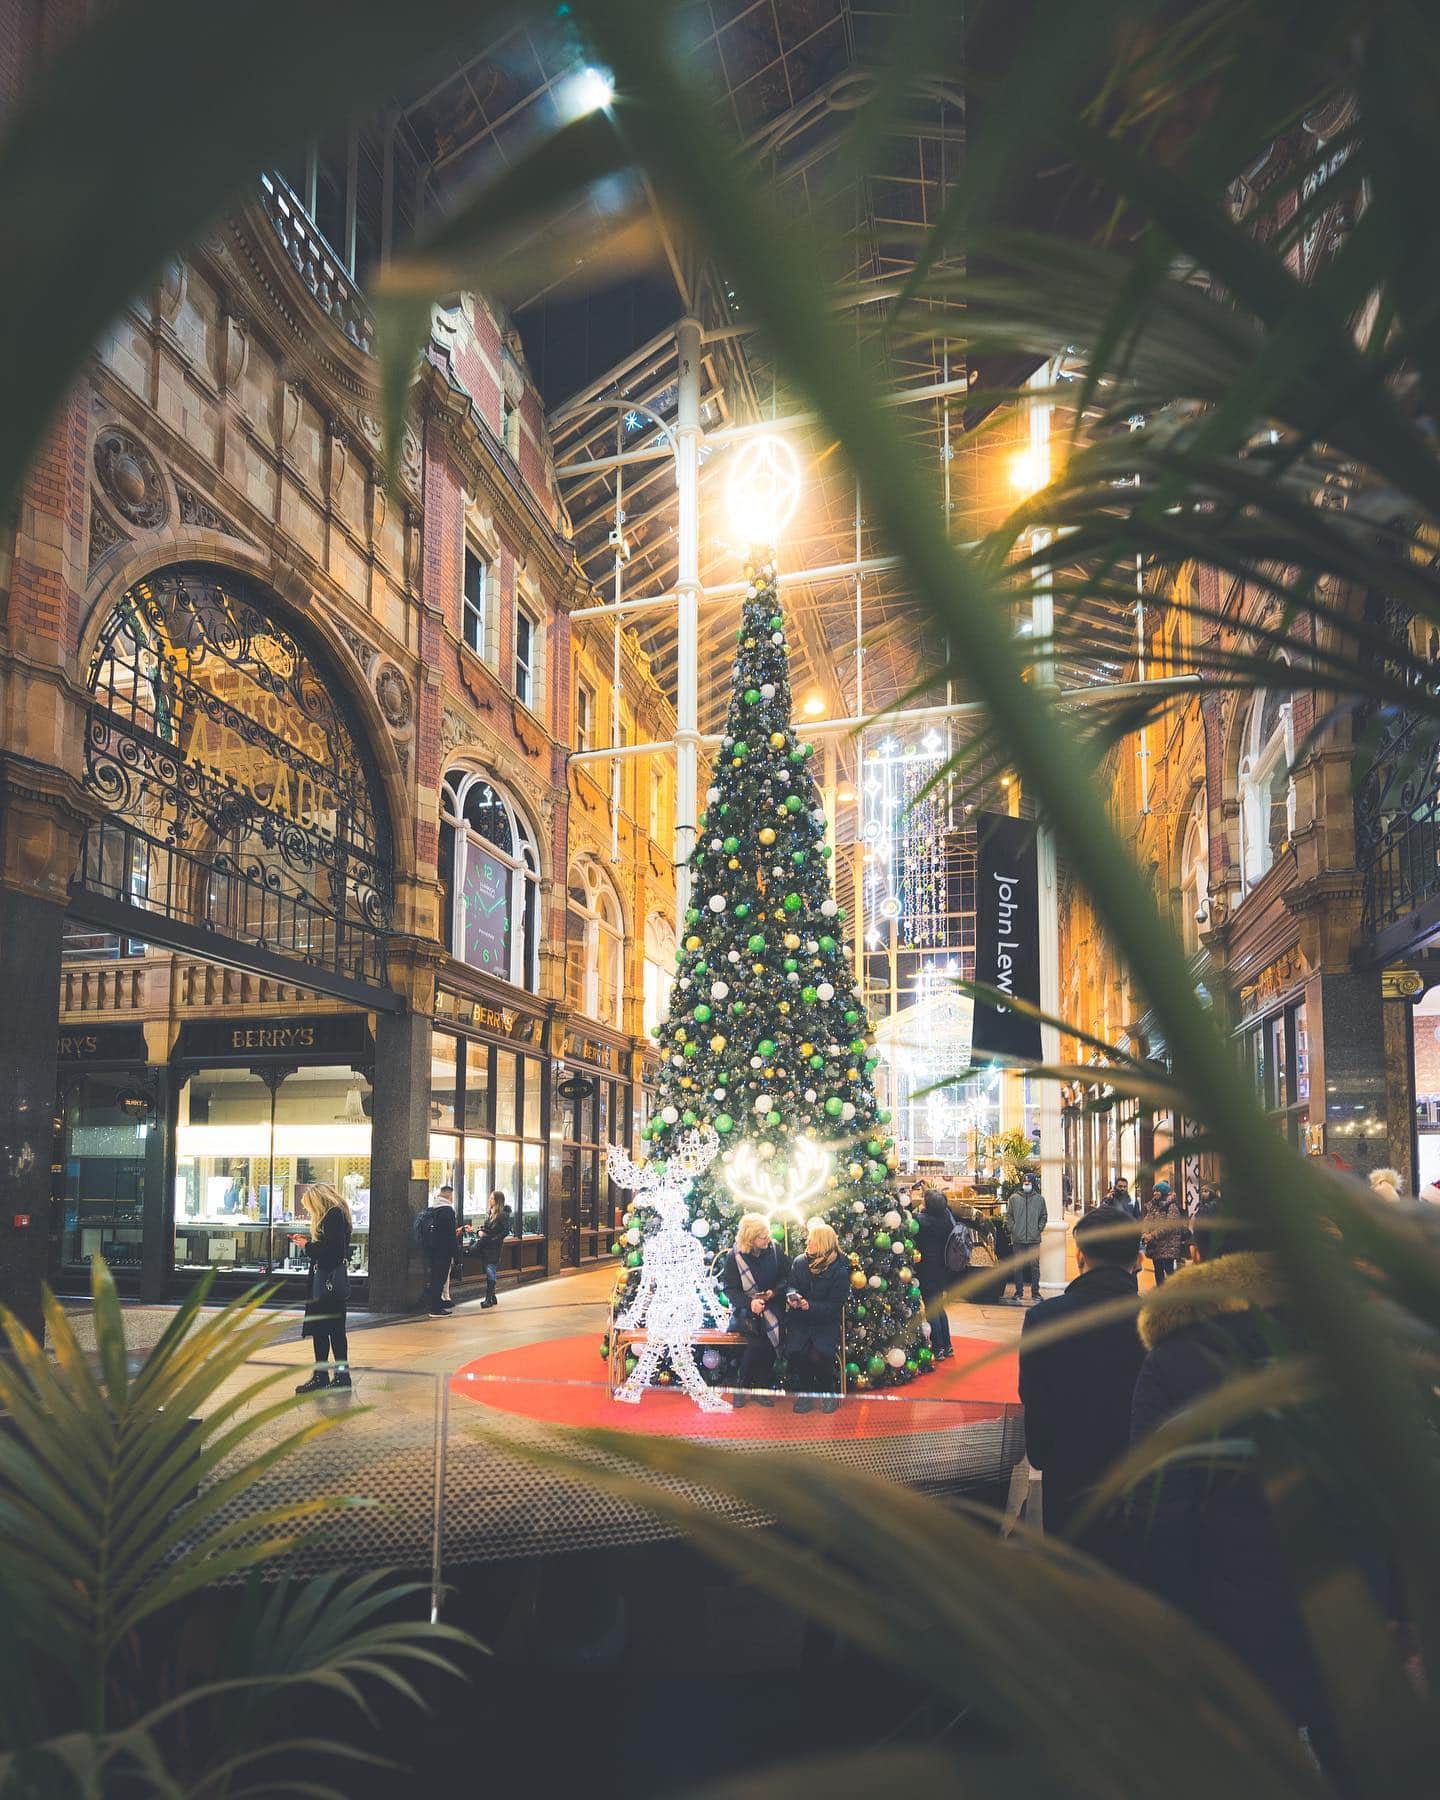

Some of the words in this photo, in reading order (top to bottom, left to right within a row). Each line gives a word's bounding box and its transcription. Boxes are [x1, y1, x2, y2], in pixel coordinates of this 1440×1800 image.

[183, 709, 338, 839] ARCADE
[483, 863, 493, 881] 12
[993, 871, 1020, 935] John
[503, 916, 510, 932] 3
[482, 948, 490, 963] 6
